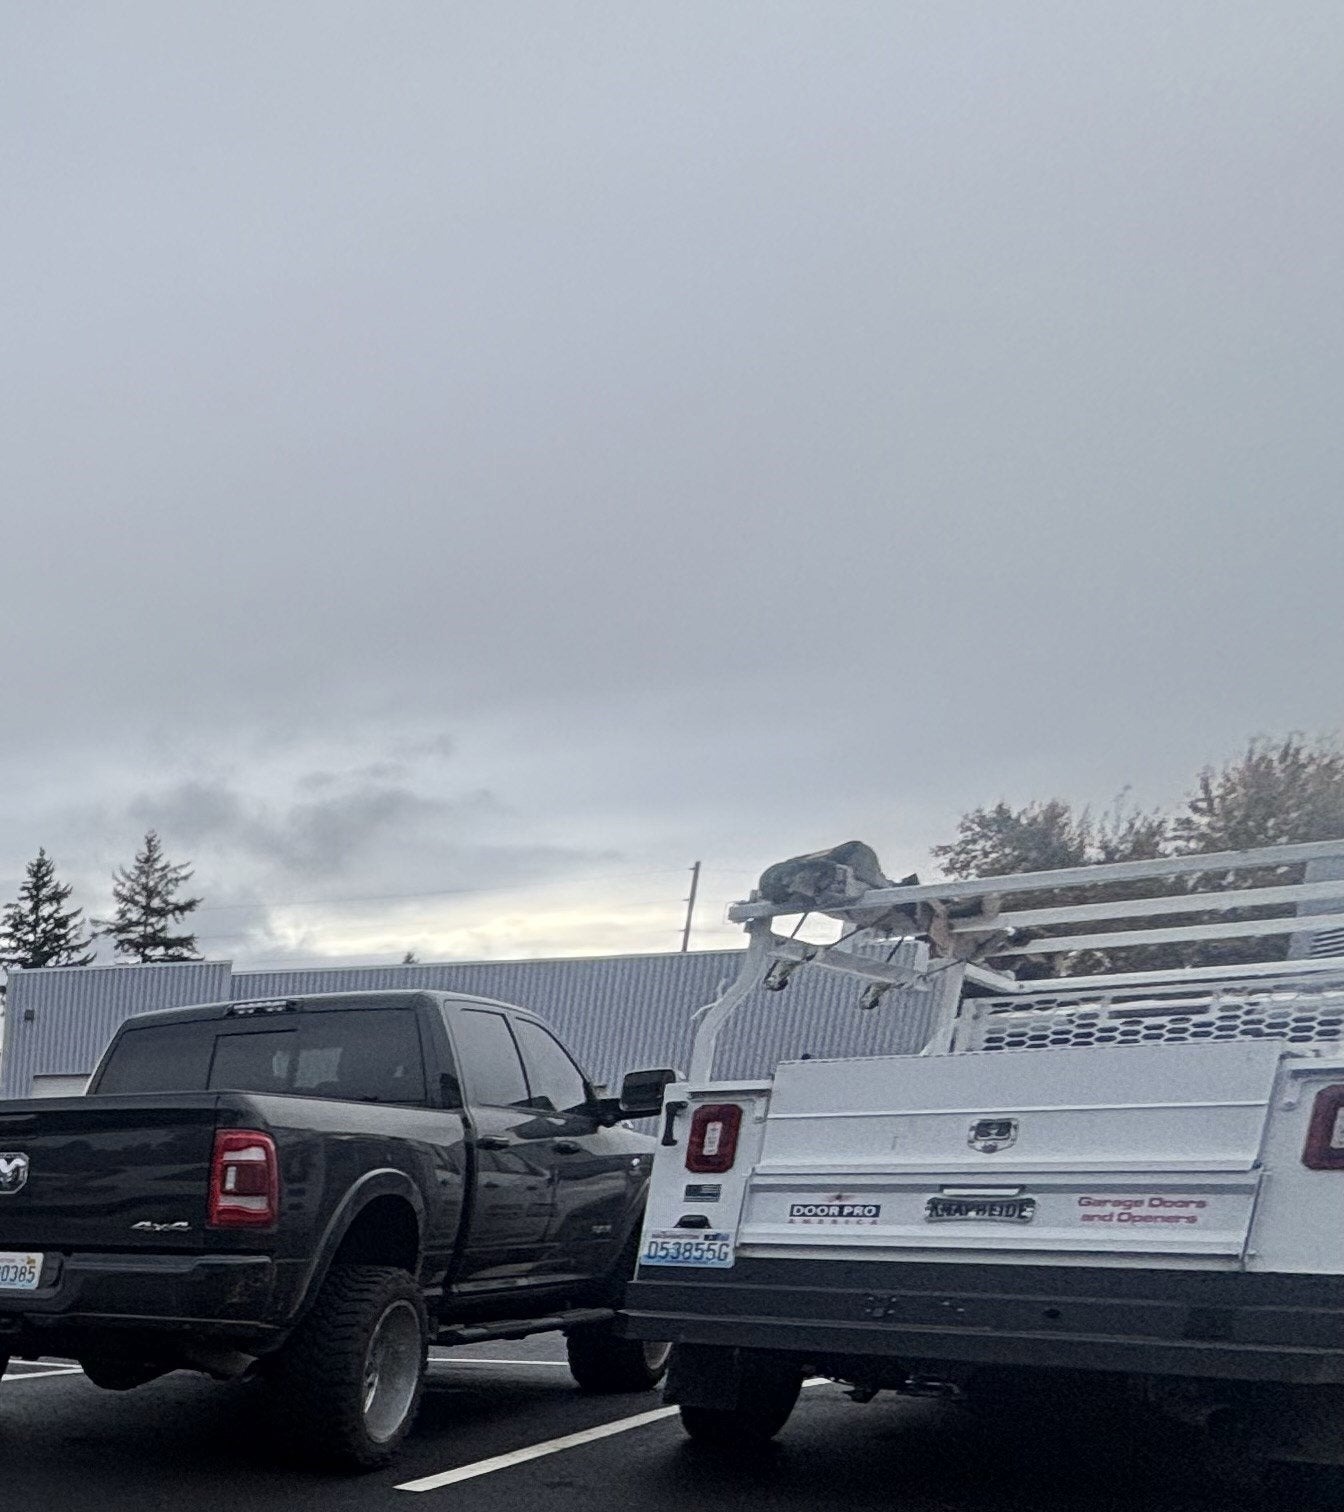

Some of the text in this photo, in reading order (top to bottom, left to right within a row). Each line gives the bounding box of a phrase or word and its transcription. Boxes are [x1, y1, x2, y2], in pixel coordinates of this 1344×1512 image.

[1078, 1196, 1206, 1210] Garage Doors
[792, 1205, 877, 1216] DOOR PRO
[1081, 1211, 1198, 1224] and Openers
